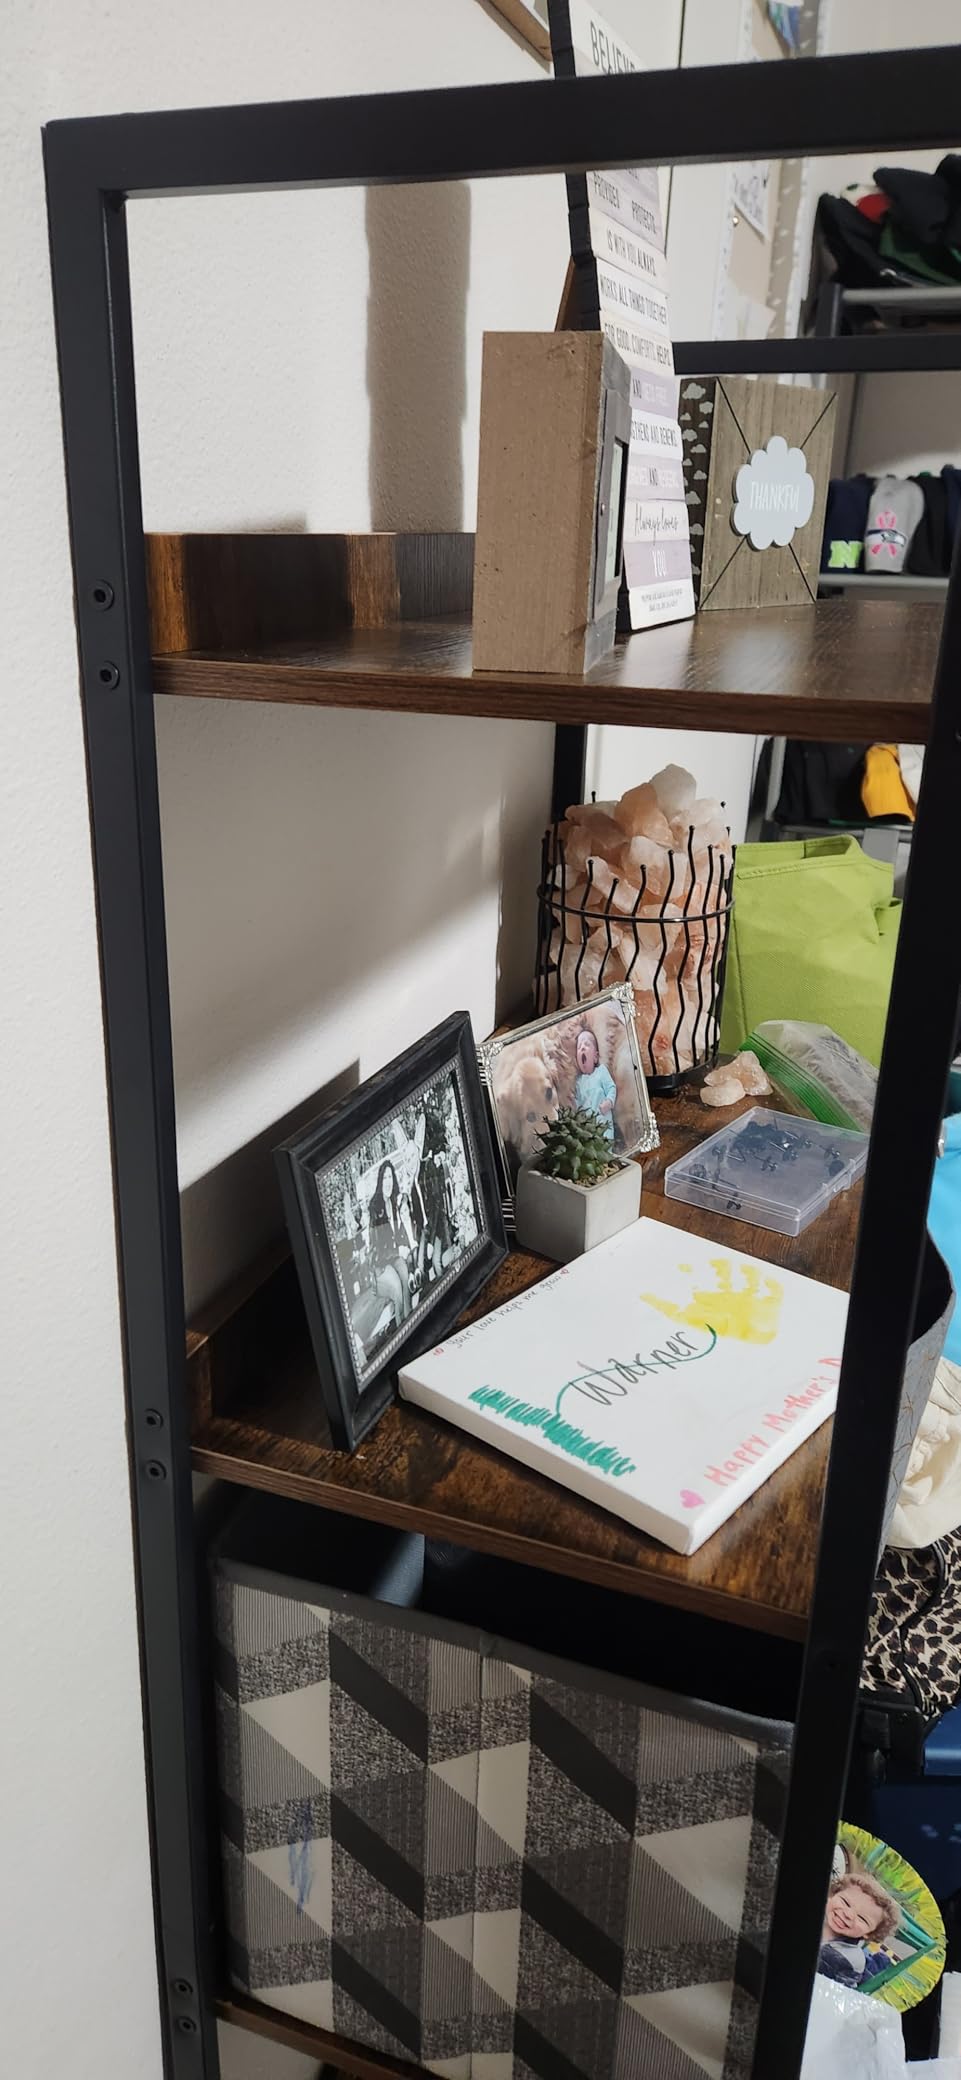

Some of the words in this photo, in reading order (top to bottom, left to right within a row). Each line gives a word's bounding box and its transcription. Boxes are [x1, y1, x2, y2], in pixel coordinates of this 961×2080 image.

[590, 19, 636, 73] BELIE
[607, 229, 614, 252] IS
[614, 233, 626, 259] WITH
[626, 242, 637, 266] YOU
[600, 273, 618, 302] WORKS
[618, 281, 629, 307] ALL
[629, 288, 645, 315] THINGS
[645, 297, 667, 326] TOGETHER
[632, 379, 642, 399] AND
[650, 424, 660, 445] AND
[648, 467, 660, 487] AND
[652, 550, 666, 577] YOU
[828, 540, 864, 569] N
[474, 1316, 497, 1331] love
[524, 1290, 538, 1301] me
[568, 1331, 699, 1406] Warner
